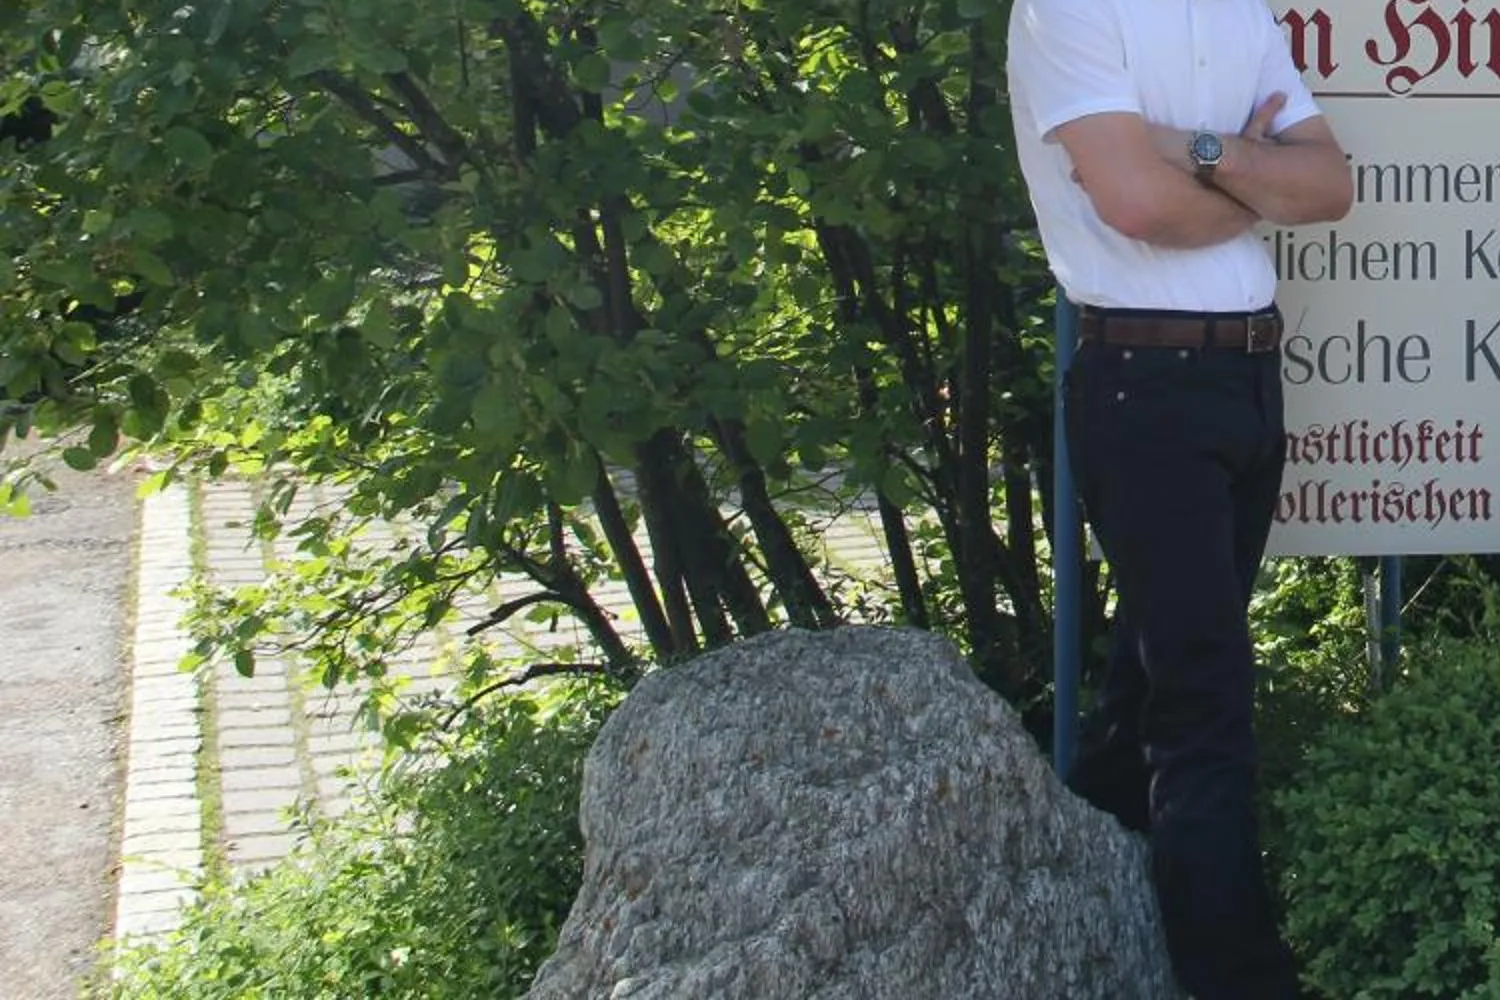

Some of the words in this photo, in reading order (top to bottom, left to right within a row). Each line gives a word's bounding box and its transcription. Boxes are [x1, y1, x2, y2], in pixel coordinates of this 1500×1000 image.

[1264, 230, 1437, 281] lichem
[1284, 319, 1431, 385] sche
[1273, 477, 1492, 531] ollerischen
